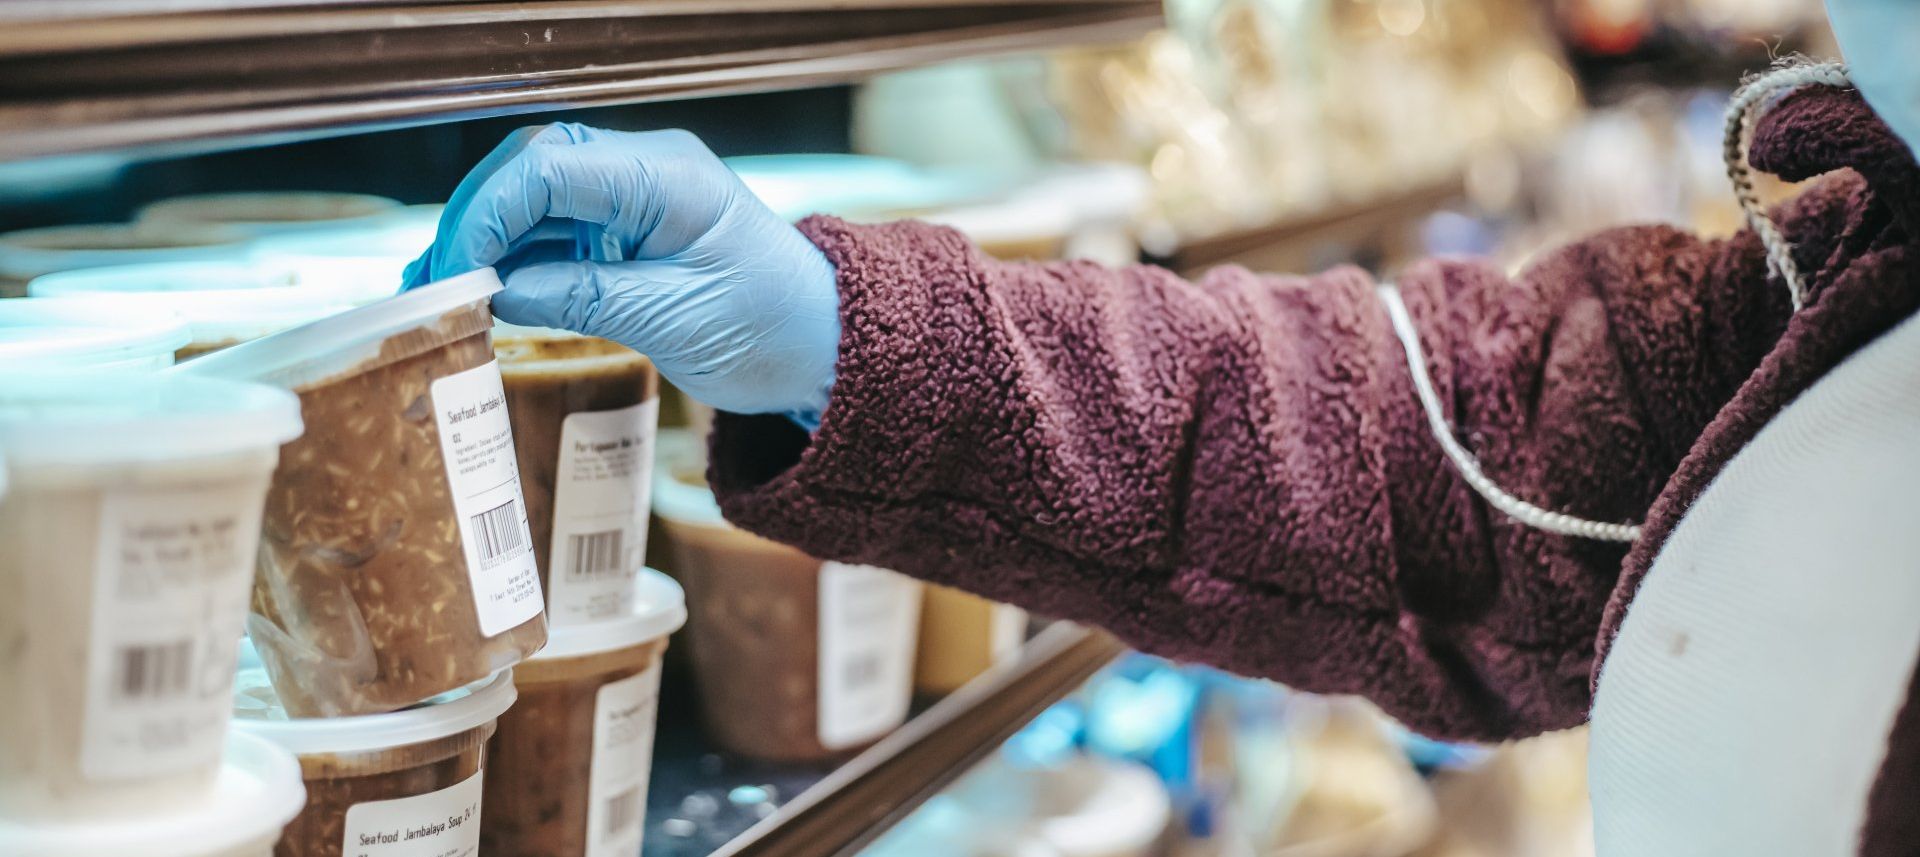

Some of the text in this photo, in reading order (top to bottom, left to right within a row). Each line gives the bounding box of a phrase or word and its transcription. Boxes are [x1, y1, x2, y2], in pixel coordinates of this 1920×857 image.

[448, 404, 477, 424] Seafood
[359, 830, 399, 846] Seafood
[403, 821, 445, 841] Jambalaya
[448, 815, 463, 829] Soup
